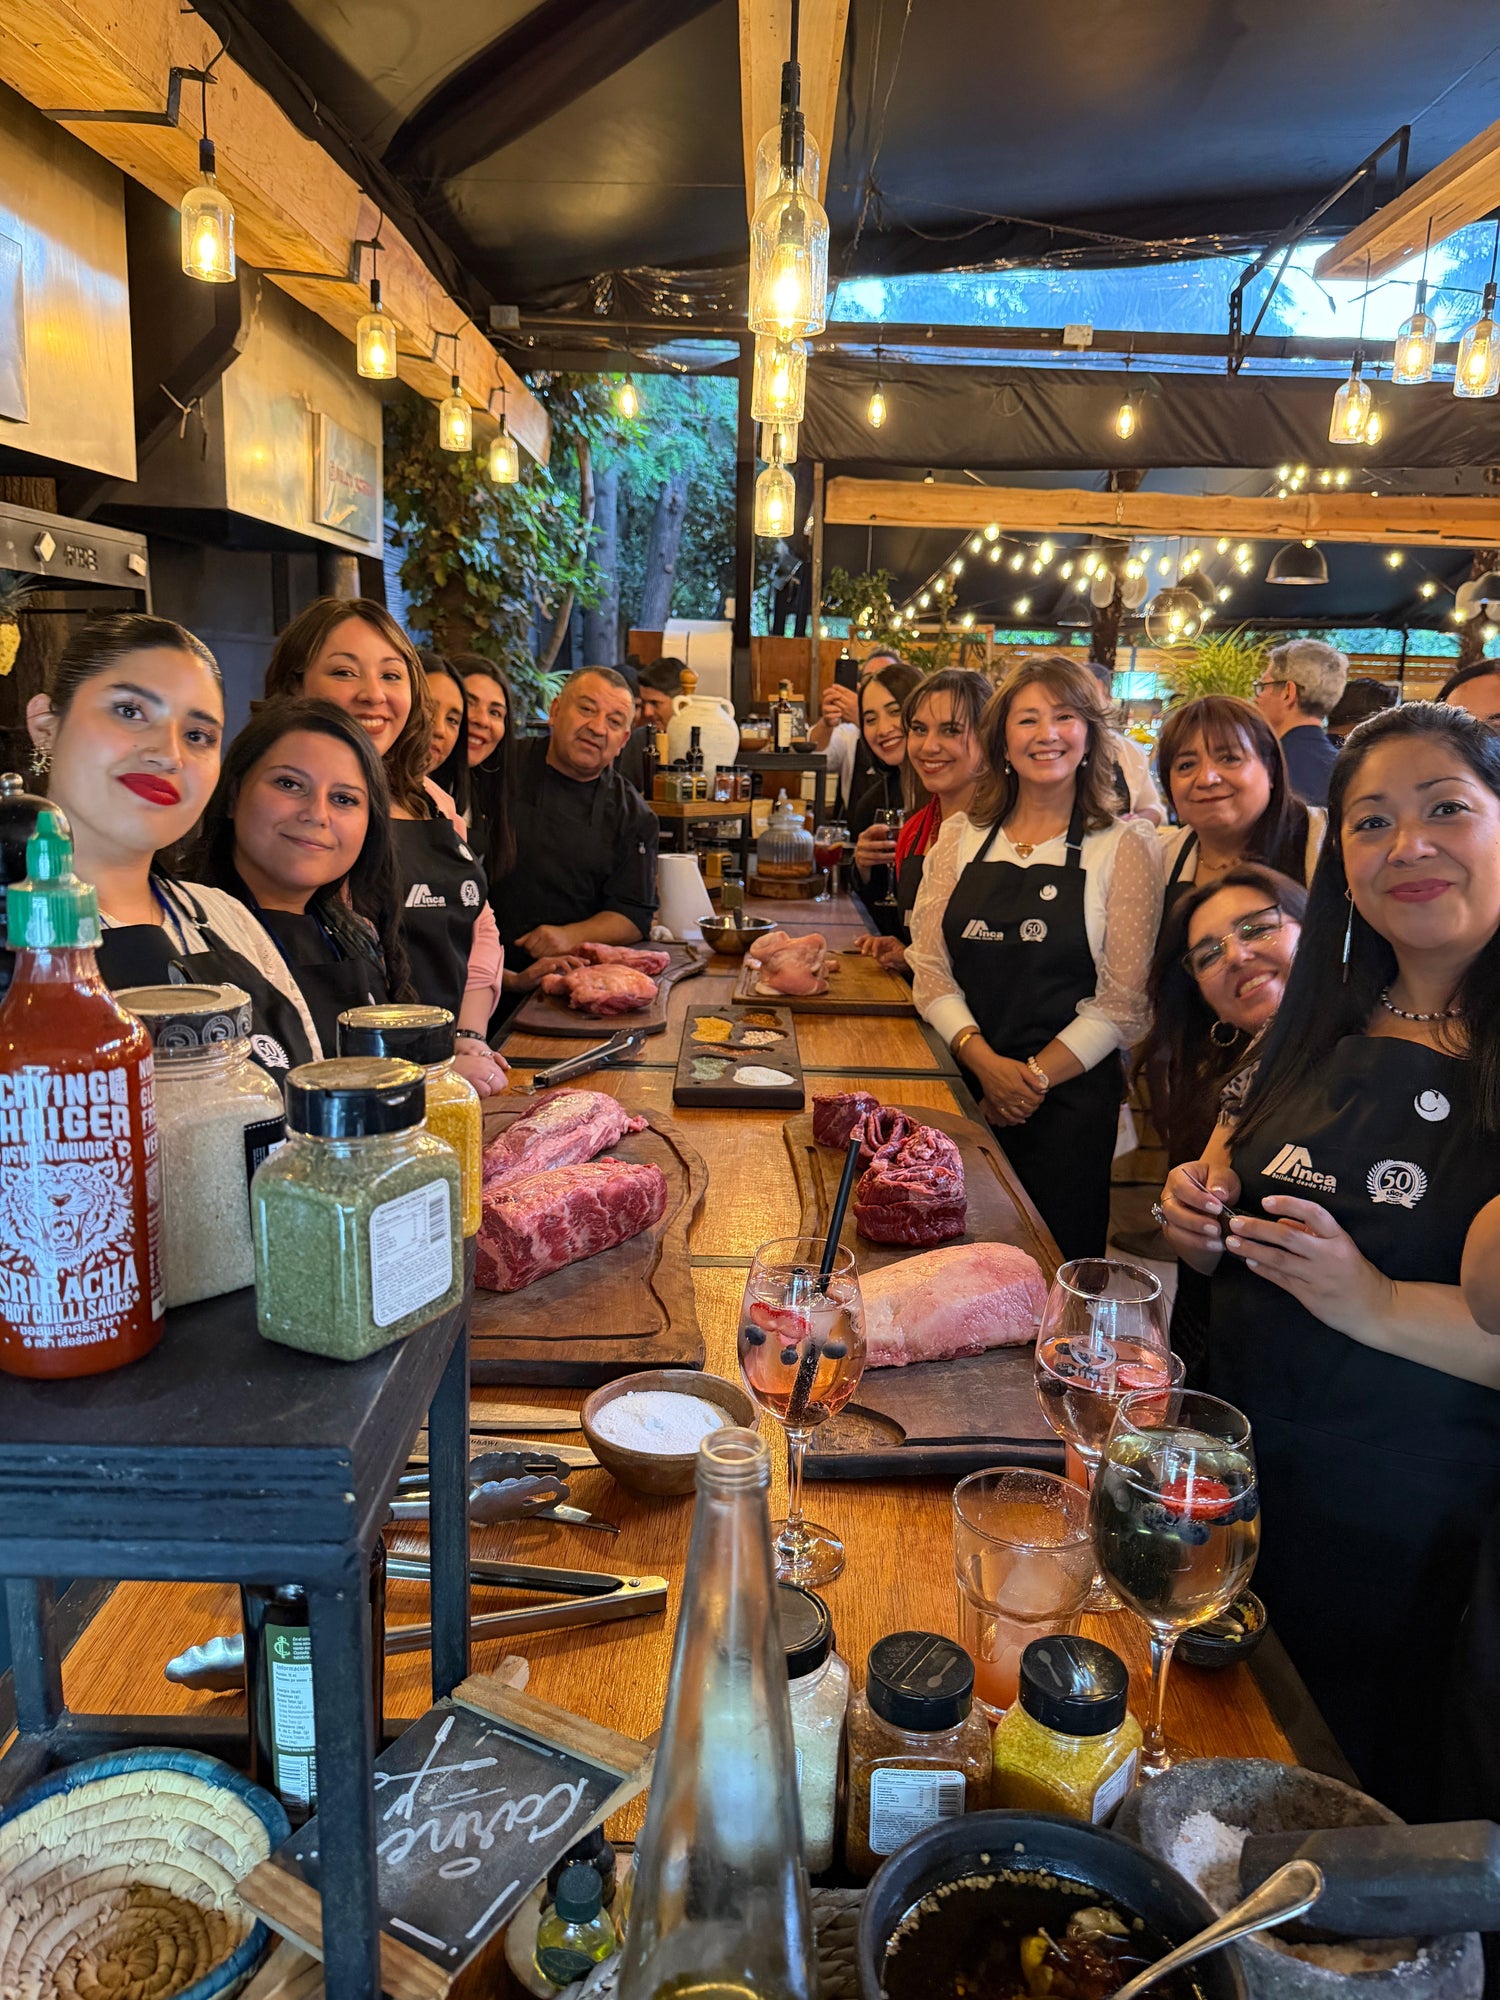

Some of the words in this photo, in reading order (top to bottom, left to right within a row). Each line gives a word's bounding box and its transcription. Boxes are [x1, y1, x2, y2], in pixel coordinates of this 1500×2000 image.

[1026, 924, 1041, 937] 50
[0, 1070, 109, 1110] CRYING
[0, 1105, 131, 1143] HAIGER
[1291, 1163, 1337, 1187] Inca
[1295, 1179, 1317, 1189] desde
[1318, 1184, 1336, 1194] 1975
[1382, 1170, 1411, 1190] 50
[0, 1254, 140, 1304] SRIRACHA
[5, 1302, 30, 1324] HOT
[32, 1301, 86, 1325] CHILLI
[87, 1290, 134, 1319] SAUCE
